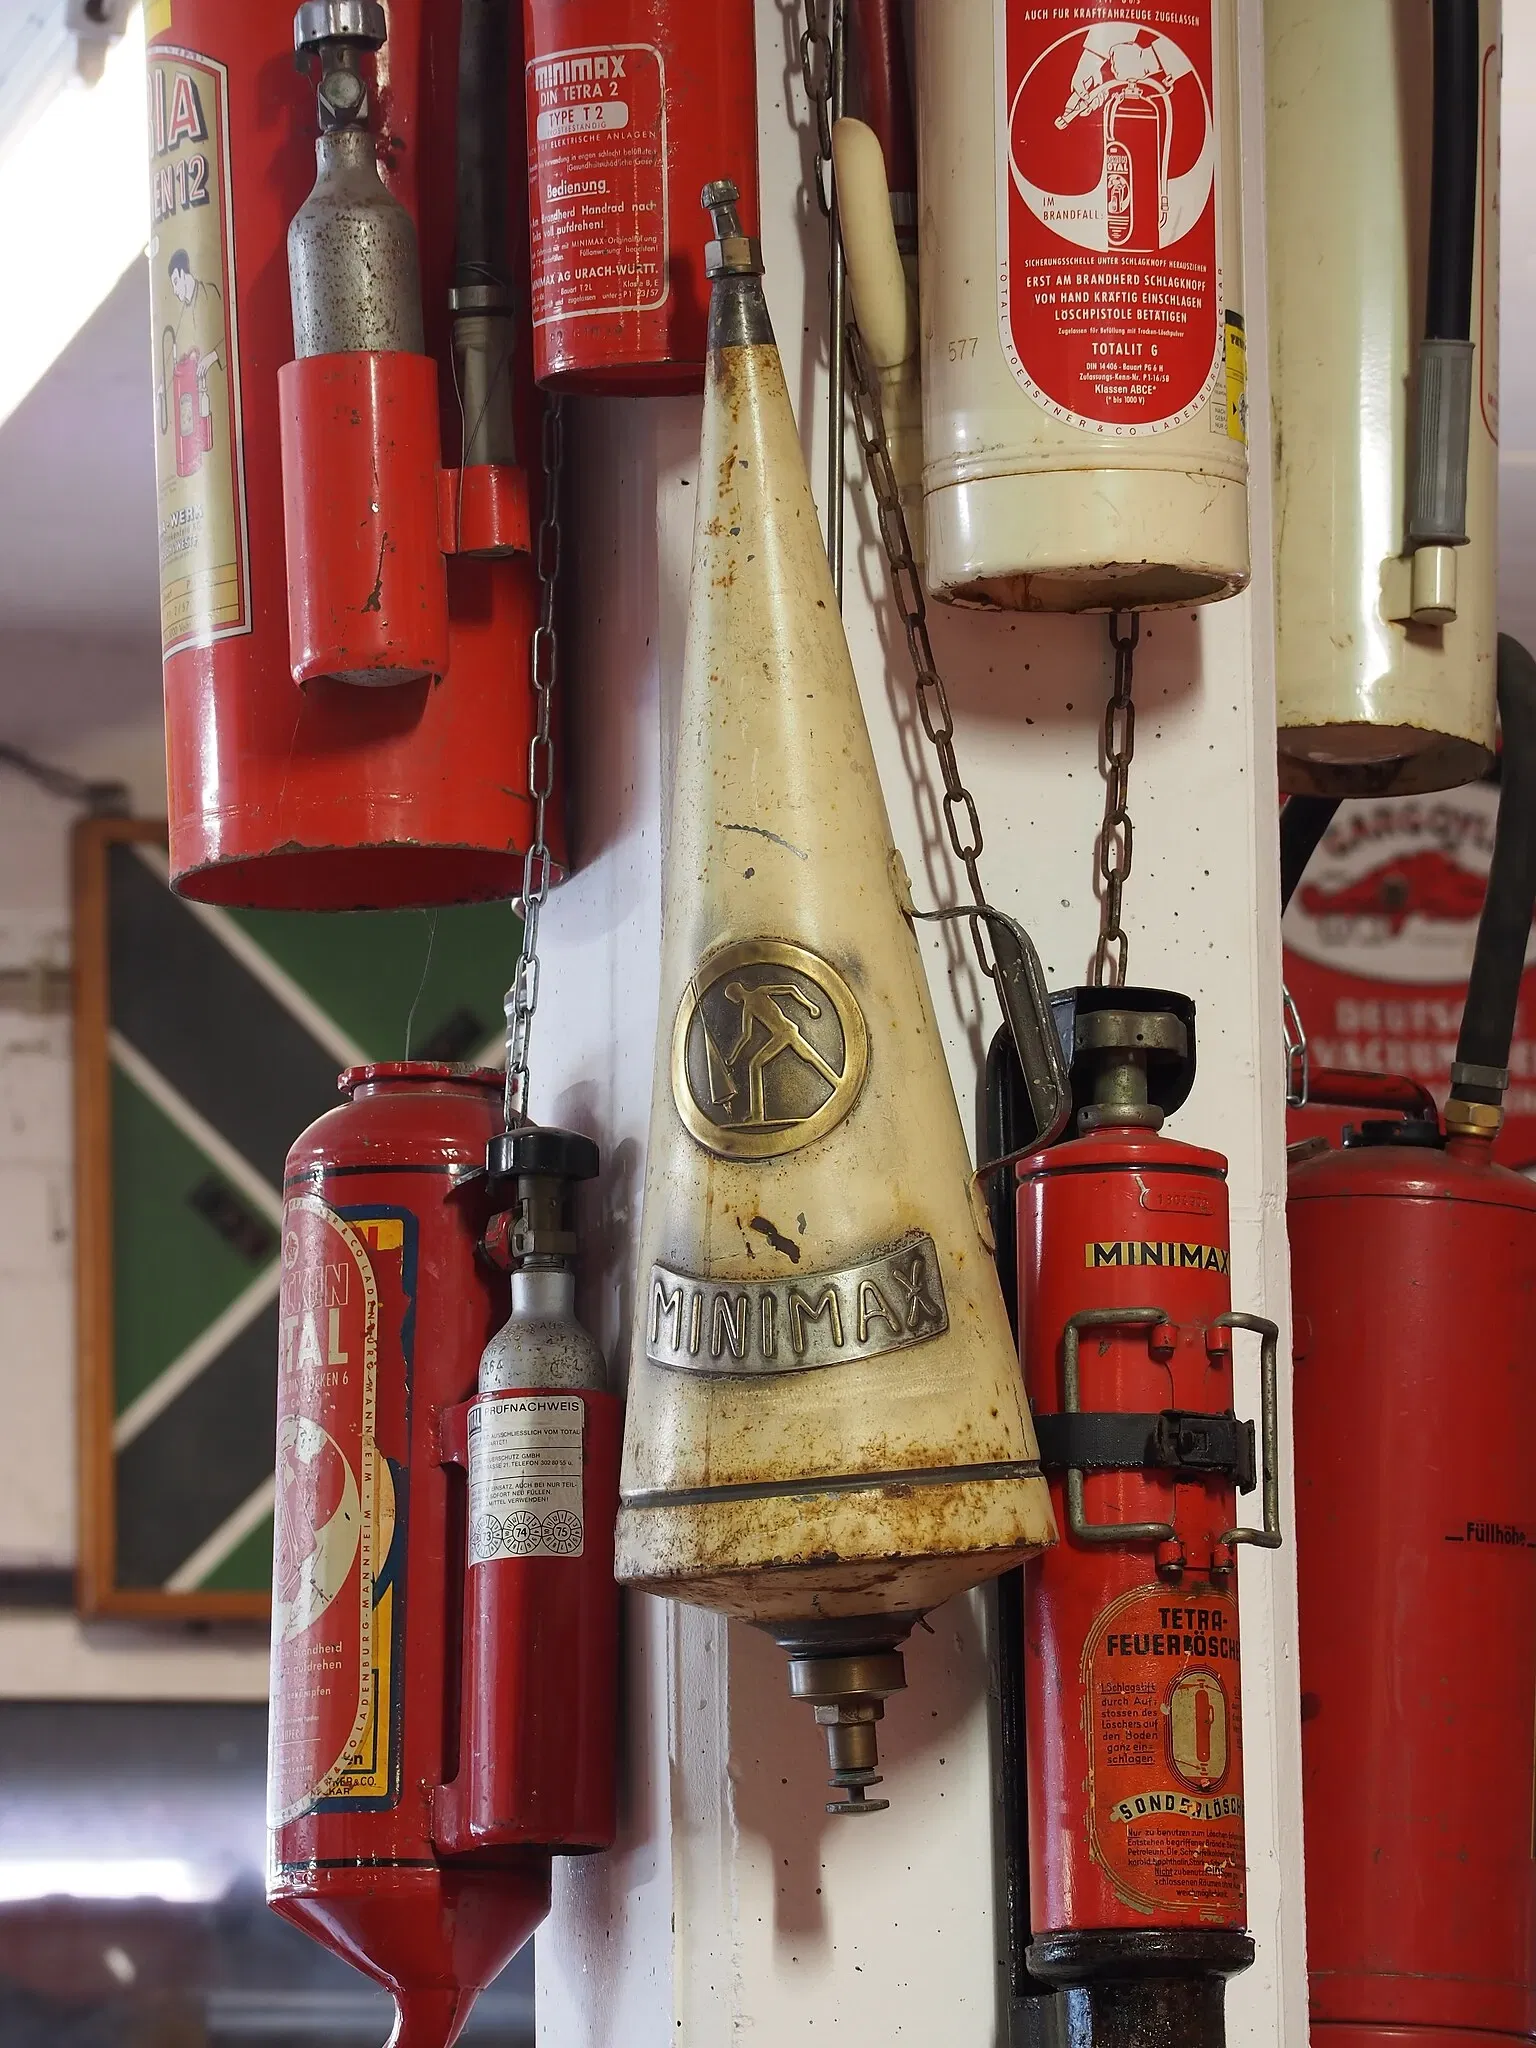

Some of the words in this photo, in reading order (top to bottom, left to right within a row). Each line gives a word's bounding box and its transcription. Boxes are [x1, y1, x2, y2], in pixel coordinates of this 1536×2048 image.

[1024, 8, 1048, 21] AUCH
[1073, 7, 1151, 20] KRAFTFAHRZEUGE
[1154, 11, 1199, 26] ZUGELASSEN
[534, 55, 626, 91] MINIMAX
[540, 87, 558, 107] DIN
[563, 83, 603, 101] TETRA
[609, 81, 619, 96] 2
[549, 108, 574, 127] TYPE
[583, 106, 591, 121] T
[595, 105, 604, 120] 2
[550, 133, 601, 149] ELEKTRISCHE
[606, 130, 656, 140] ANLAGEN
[546, 179, 607, 198] Bedienung
[581, 201, 625, 215] Handrad
[631, 199, 657, 212] nach
[1043, 197, 1055, 207] IM
[556, 219, 604, 235] aufdrehen!
[571, 237, 605, 247] MINIMAX
[1024, 257, 1095, 267] SICHERUNGSSCHELLE
[1097, 257, 1119, 265] UNTER
[1121, 257, 1167, 267] SCHLAGKNOPF
[1168, 260, 1207, 273] HERAUSZIEHEN
[557, 271, 571, 284] AG
[1026, 275, 1051, 288] ERST
[1055, 274, 1072, 286] AM
[1076, 274, 1140, 286] BRANDHERD
[1144, 276, 1206, 292] SCHLAGKNOPF
[1000, 261, 1008, 321] TOTAL
[1034, 293, 1056, 305] VON
[1060, 292, 1090, 304] HAND
[1094, 290, 1138, 304] KRÄFTIG
[1142, 294, 1202, 309] EINSCHLAGEN
[1055, 308, 1133, 321] LÖSCHPISTOLE
[1136, 309, 1188, 323] BETÄTIGEN
[1058, 327, 1087, 336] Zugelassen
[1100, 327, 1125, 336] Befüllung
[949, 337, 978, 362] 577
[1092, 342, 1143, 356] TOTALIT
[1151, 344, 1158, 356] G
[1086, 362, 1097, 370] DIN
[1123, 363, 1142, 371] Bauart
[1005, 343, 1087, 428] FOERSTNER
[1095, 384, 1128, 394] Klassen
[1124, 396, 1137, 404] 1000
[1094, 1242, 1229, 1274] MINIMAX
[651, 1259, 939, 1358] MINIMAX
[342, 1369, 349, 1386] 6
[491, 1429, 541, 1439] AUSSCHLIESSLICH
[515, 1527, 527, 1538] 74
[556, 1526, 568, 1537] 75
[1158, 1608, 1228, 1632] TETRA-
[1101, 1697, 1129, 1707] durch
[1101, 1709, 1139, 1718] stossen
[1141, 1708, 1158, 1717] des
[1101, 1719, 1142, 1730] Löschers
[1143, 1719, 1158, 1731] auf
[1102, 1731, 1120, 1741] den
[1107, 1743, 1131, 1754] ganz
[1156, 1828, 1190, 1836] benutzen
